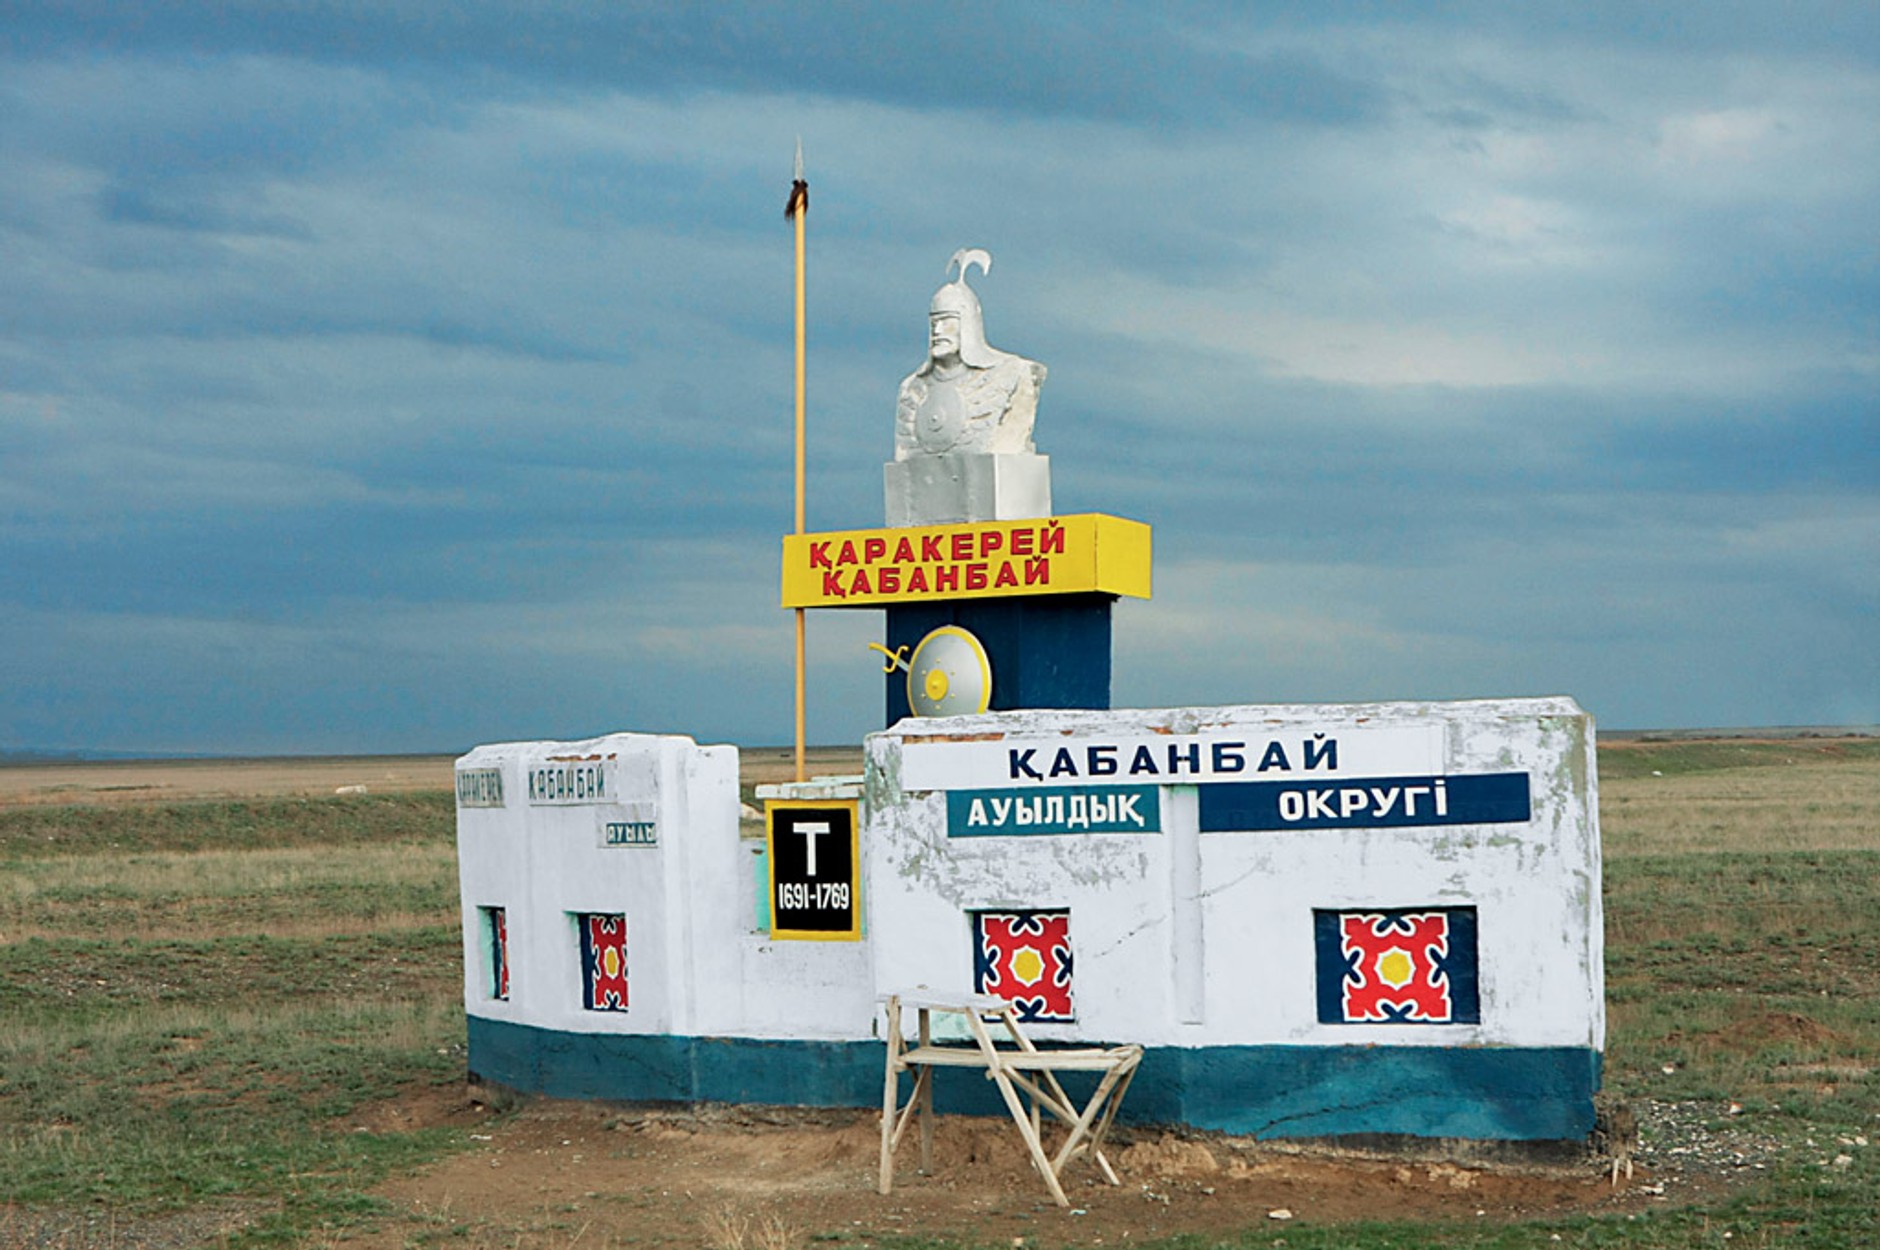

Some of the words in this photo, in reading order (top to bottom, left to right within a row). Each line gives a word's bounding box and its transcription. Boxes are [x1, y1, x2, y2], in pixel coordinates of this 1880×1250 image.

[810, 521, 1065, 570] ҚАРАКЕРЕЙ
[822, 555, 1049, 598] ҚАБАНБАЙ
[1009, 733, 1337, 782] ҚАБАНБАЙ
[967, 794, 1148, 831] АУЫЛДЫҚ
[1279, 780, 1448, 822] ОКРУГІ
[778, 882, 850, 910] 1691-1769
